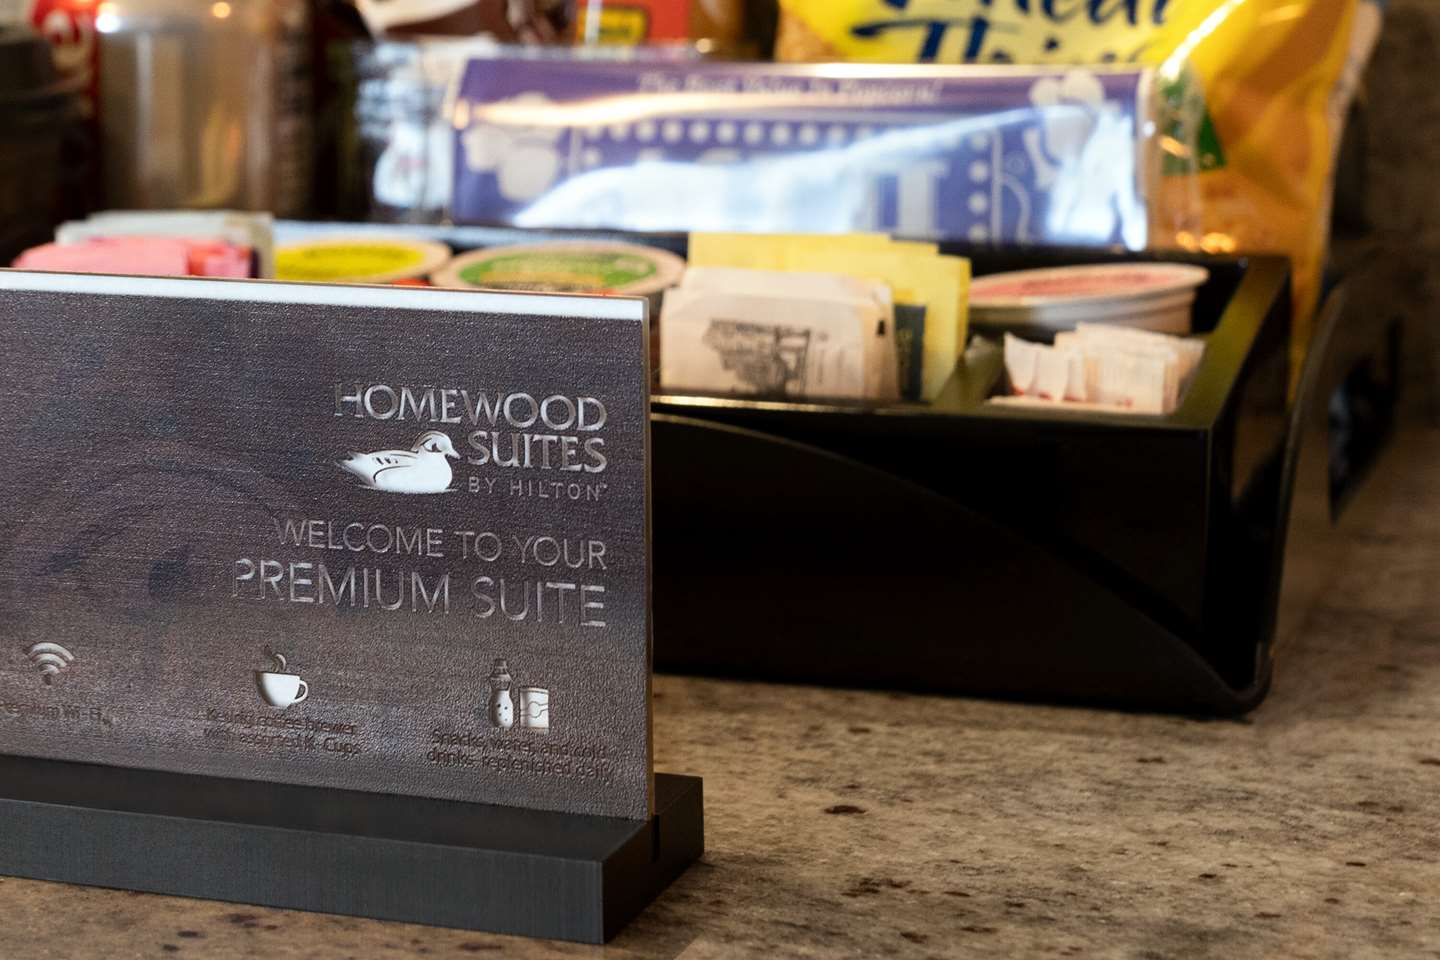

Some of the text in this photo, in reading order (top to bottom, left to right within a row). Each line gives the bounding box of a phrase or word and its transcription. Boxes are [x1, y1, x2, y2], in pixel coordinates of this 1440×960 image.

[334, 383, 608, 431] HOMEWOOD
[467, 430, 608, 473] SUITES
[468, 476, 496, 494] BY
[274, 518, 608, 570] WELCOME TO YOUR
[231, 557, 607, 627] PREMIUM SUITE
